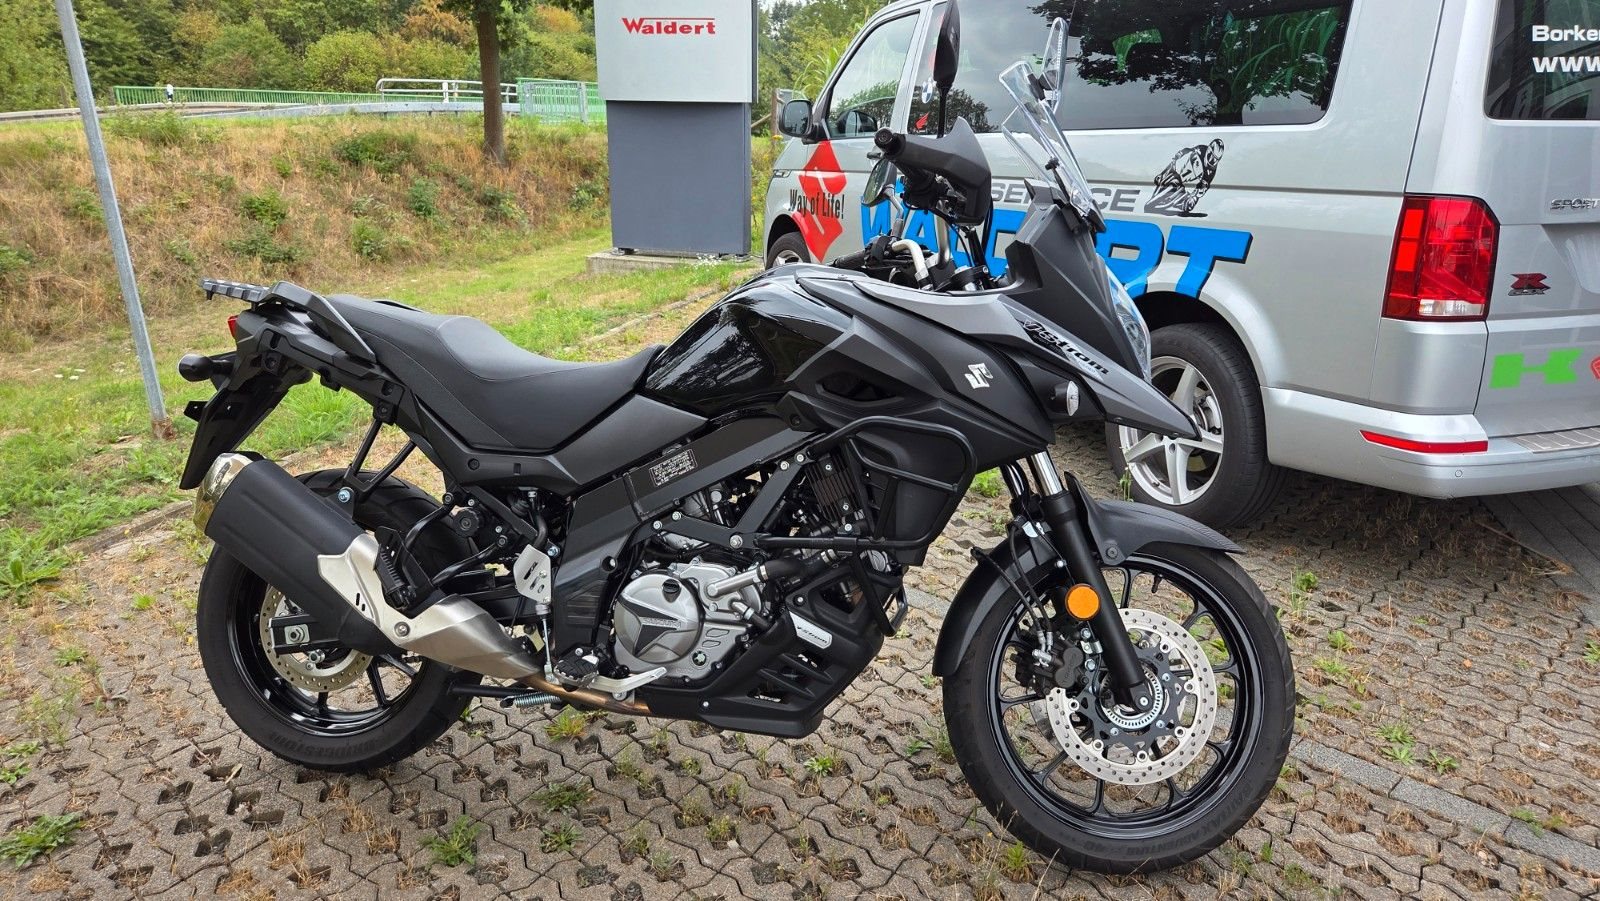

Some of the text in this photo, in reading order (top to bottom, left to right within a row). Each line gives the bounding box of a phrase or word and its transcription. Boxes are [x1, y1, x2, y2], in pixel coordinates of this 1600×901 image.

[621, 17, 716, 35] Waldert
[1532, 24, 1600, 42] Borke
[788, 189, 845, 220] Way of Life!
